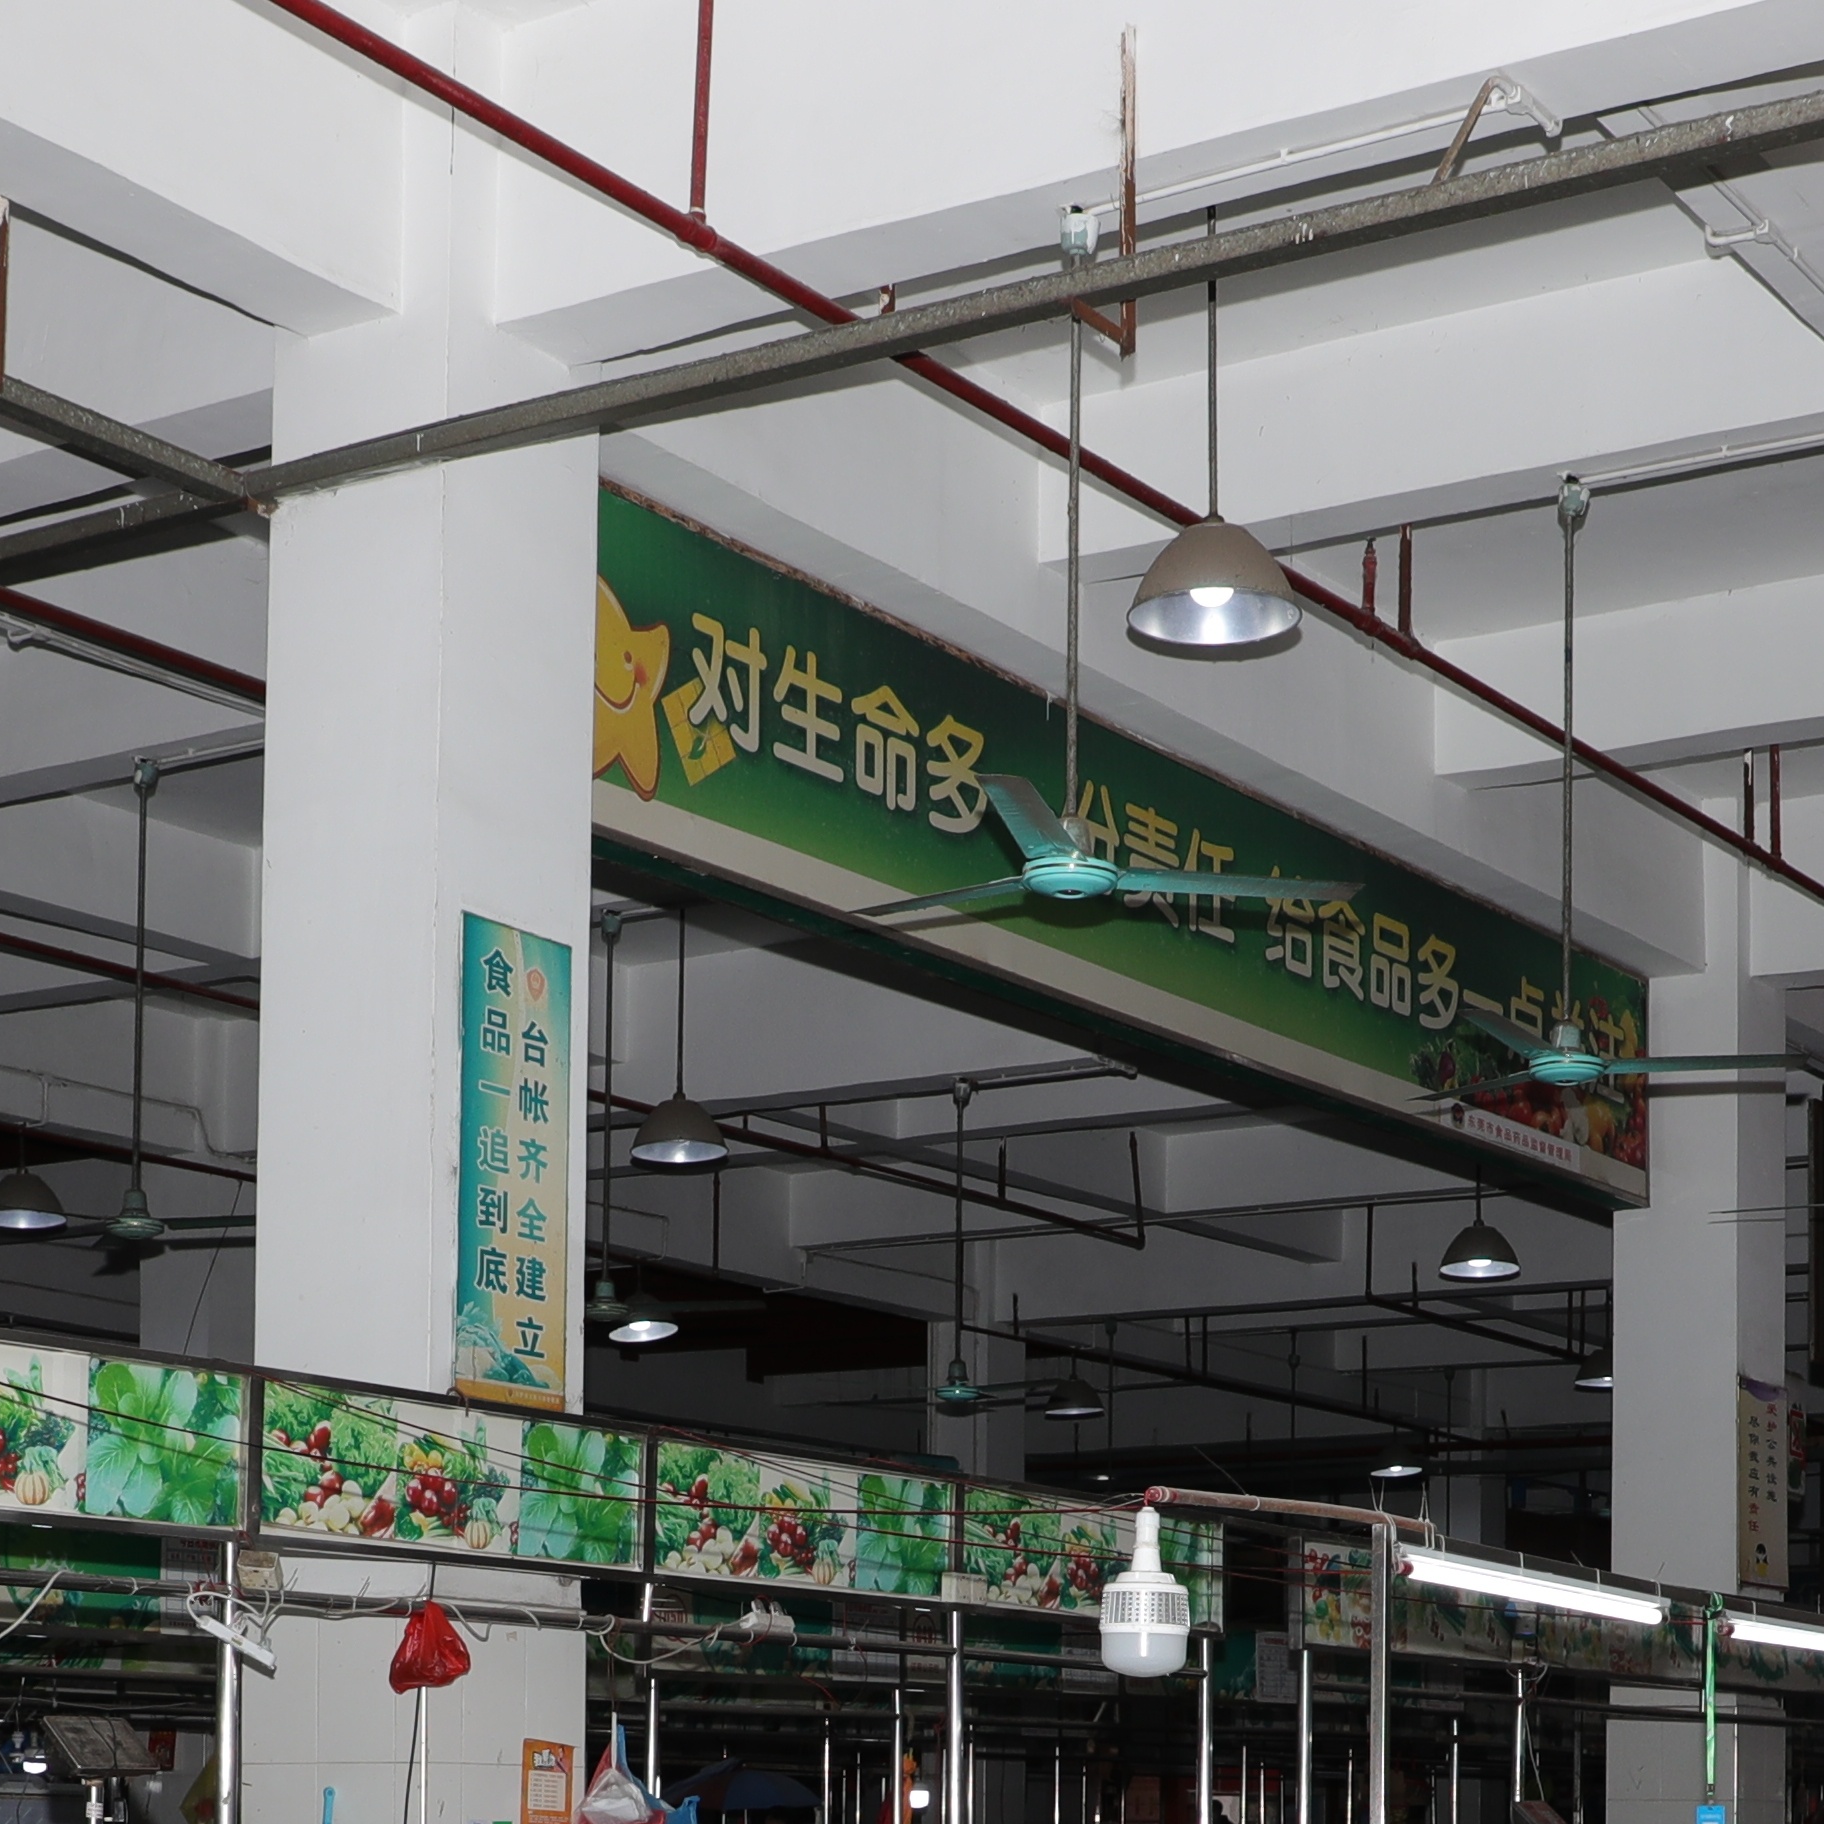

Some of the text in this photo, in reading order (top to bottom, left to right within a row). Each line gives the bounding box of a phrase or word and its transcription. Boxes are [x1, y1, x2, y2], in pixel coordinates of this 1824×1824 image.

[688, 611, 1237, 944] 对生命多分责任
[476, 947, 515, 1295] 食品一追到底
[513, 1019, 550, 1359] 台帐齐全建立
